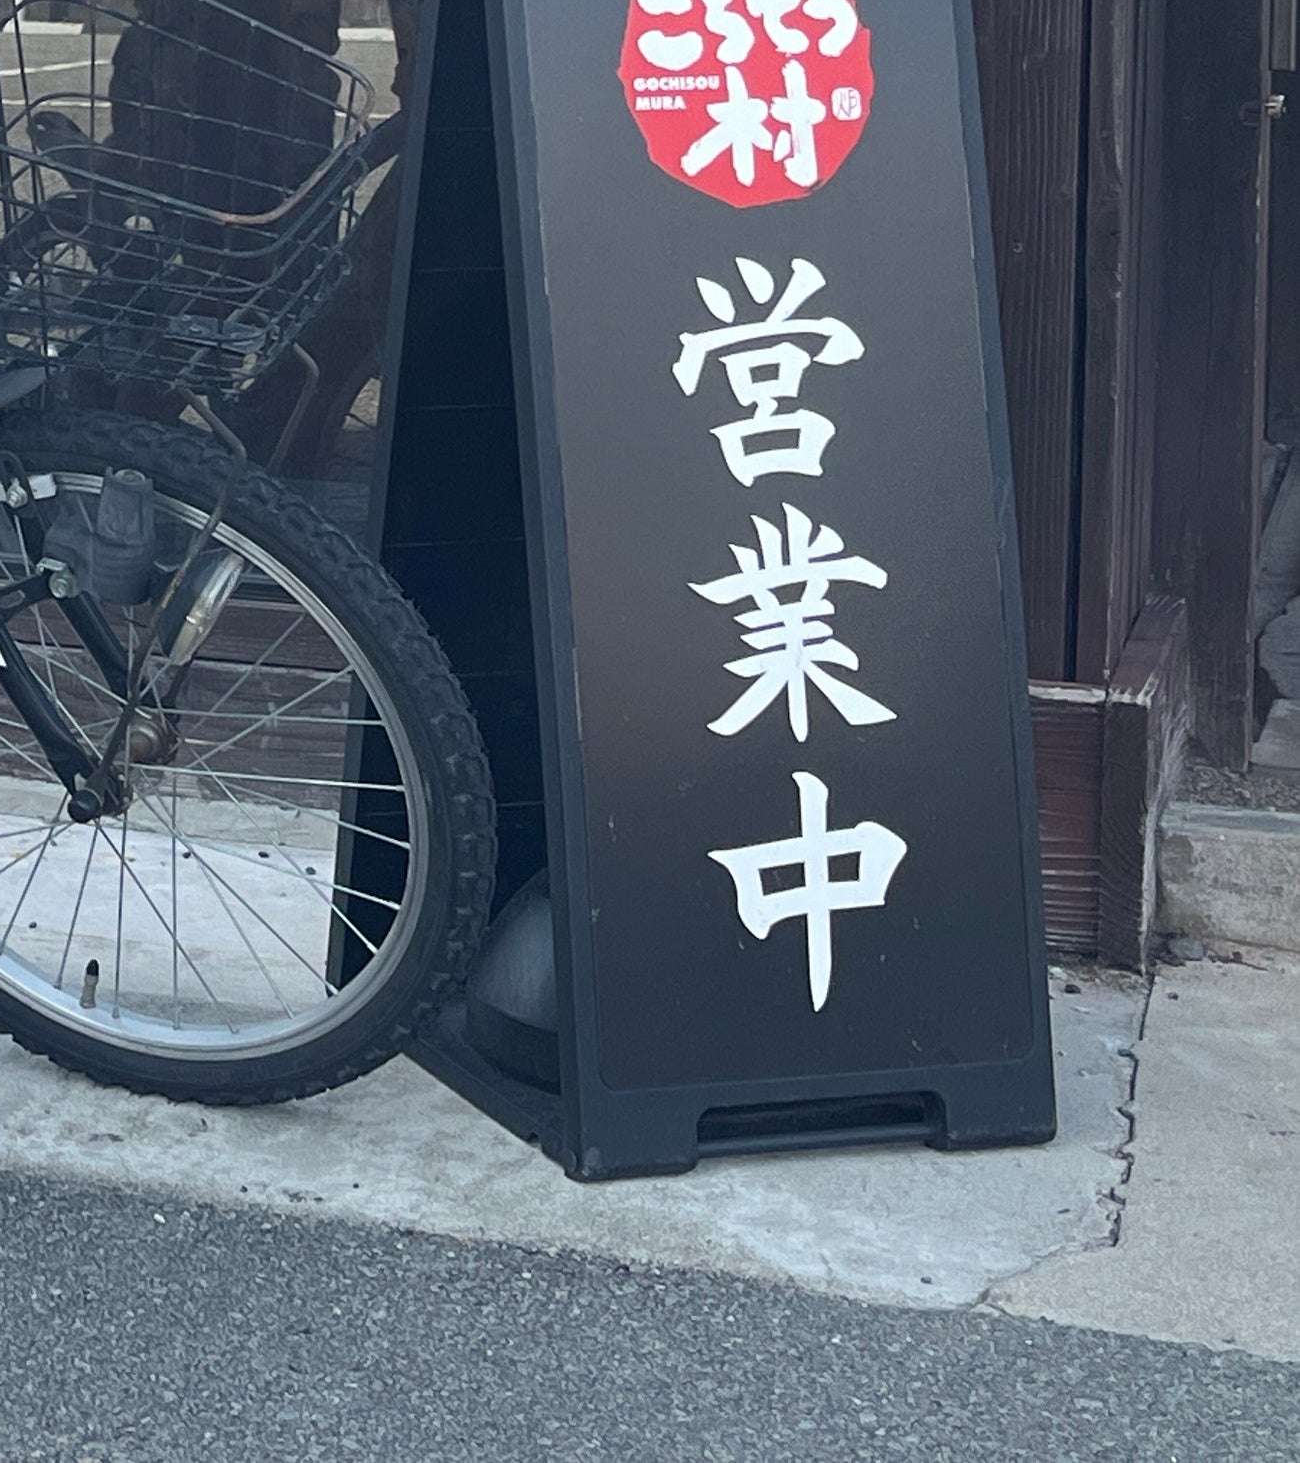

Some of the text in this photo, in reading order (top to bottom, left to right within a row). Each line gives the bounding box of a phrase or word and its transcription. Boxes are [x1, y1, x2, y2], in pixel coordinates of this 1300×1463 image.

[633, 75, 720, 93] GOCHISOU
[635, 94, 687, 111] MURA
[680, 59, 827, 187] 村
[672, 256, 907, 1013] 営業中
